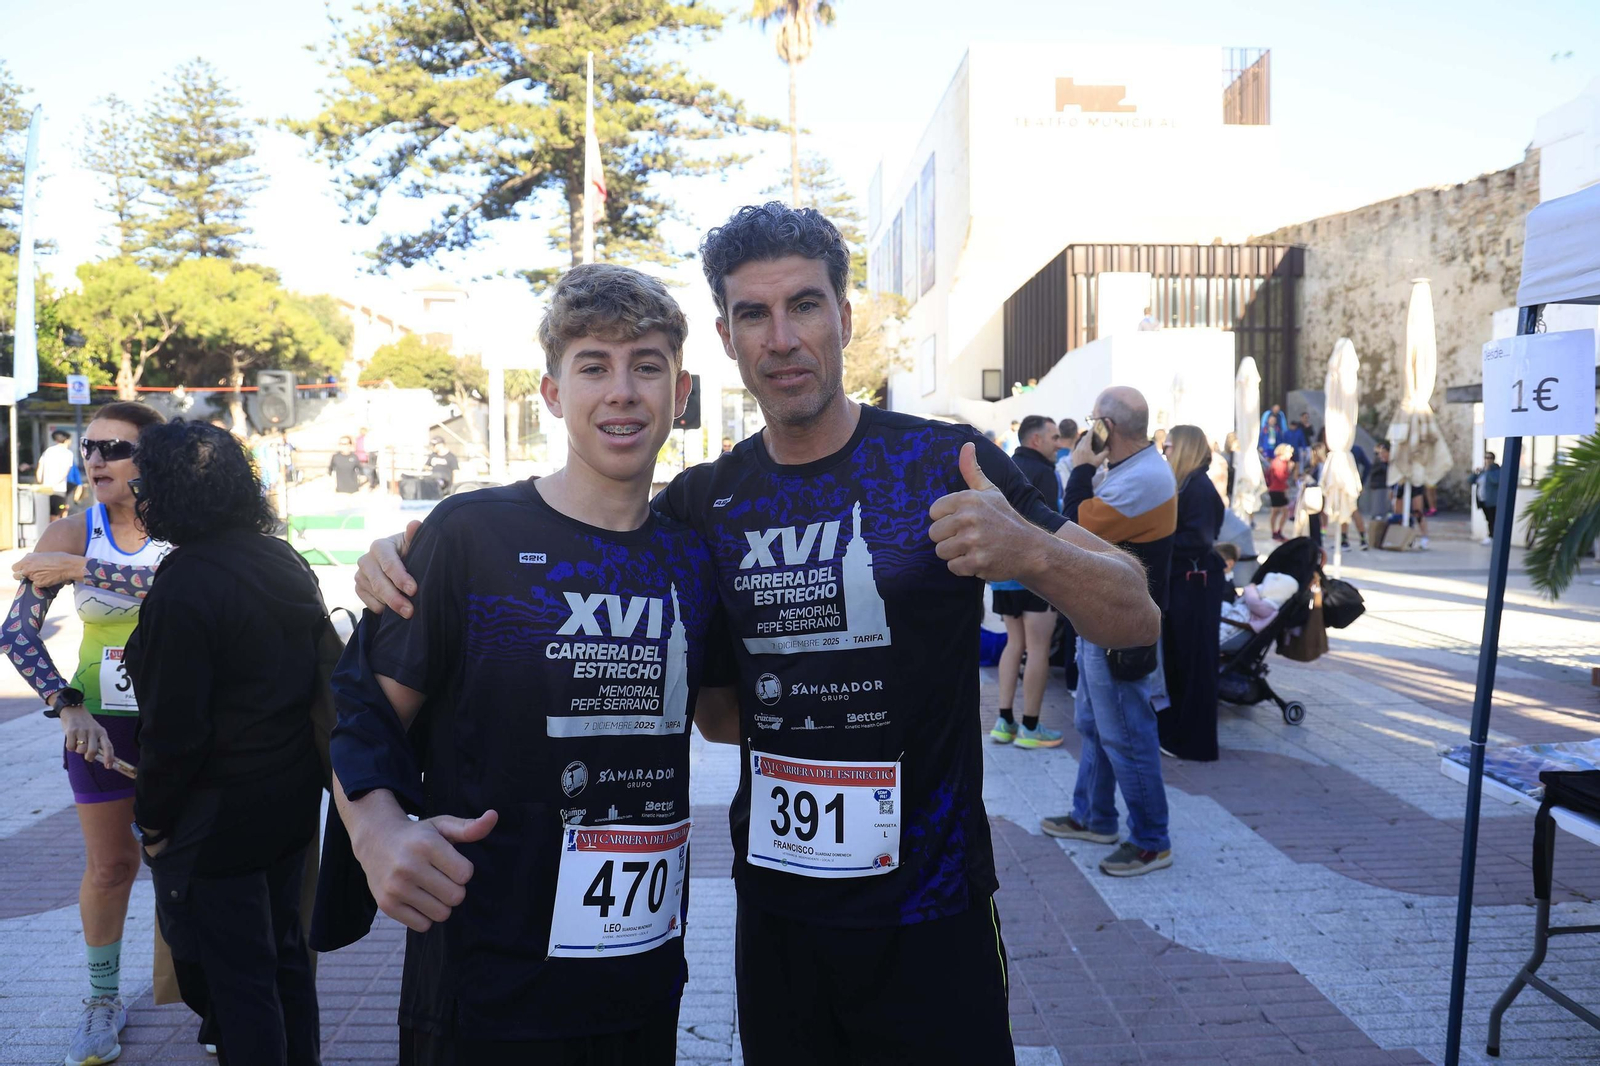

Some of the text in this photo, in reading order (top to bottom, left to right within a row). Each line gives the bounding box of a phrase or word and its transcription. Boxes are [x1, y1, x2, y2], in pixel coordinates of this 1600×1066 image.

[1014, 117, 1178, 128] TEATRO MUNICIPAL
[1511, 377, 1559, 413] 1€
[739, 520, 841, 570] XVI
[521, 554, 545, 562] 42K
[734, 566, 836, 592] CARRERA DEL
[754, 583, 838, 606] ESTRECHO
[556, 591, 663, 639] XVI
[779, 604, 840, 620] MEMORIAL
[757, 615, 841, 634] PEPE SERRANO
[777, 638, 820, 650] DICIEMBRE
[822, 637, 840, 646] 2025
[853, 634, 884, 644] TARIFA
[545, 642, 662, 662] CARRERA DEL
[573, 662, 662, 680] ESTRECHO
[598, 685, 660, 698] MEMORIAL
[789, 680, 884, 697] SAMARADOR
[570, 698, 660, 711] PEPE SERRANO
[821, 694, 850, 702] GRUPO
[847, 711, 888, 723] Better
[584, 721, 681, 731] 7 DICIEMBRE 2025 TARIFA
[595, 768, 675, 785] SAMARADOR
[776, 764, 814, 777] CARRERA
[816, 768, 835, 779] DEL
[837, 769, 895, 780] ESTRECHO
[627, 781, 652, 789] GRUPO
[770, 786, 844, 844] 391
[599, 834, 648, 845] CARRERA
[649, 835, 666, 845] DEL
[773, 839, 814, 855] FRANCISCO
[583, 858, 668, 918] 470
[603, 923, 622, 933] LEO
